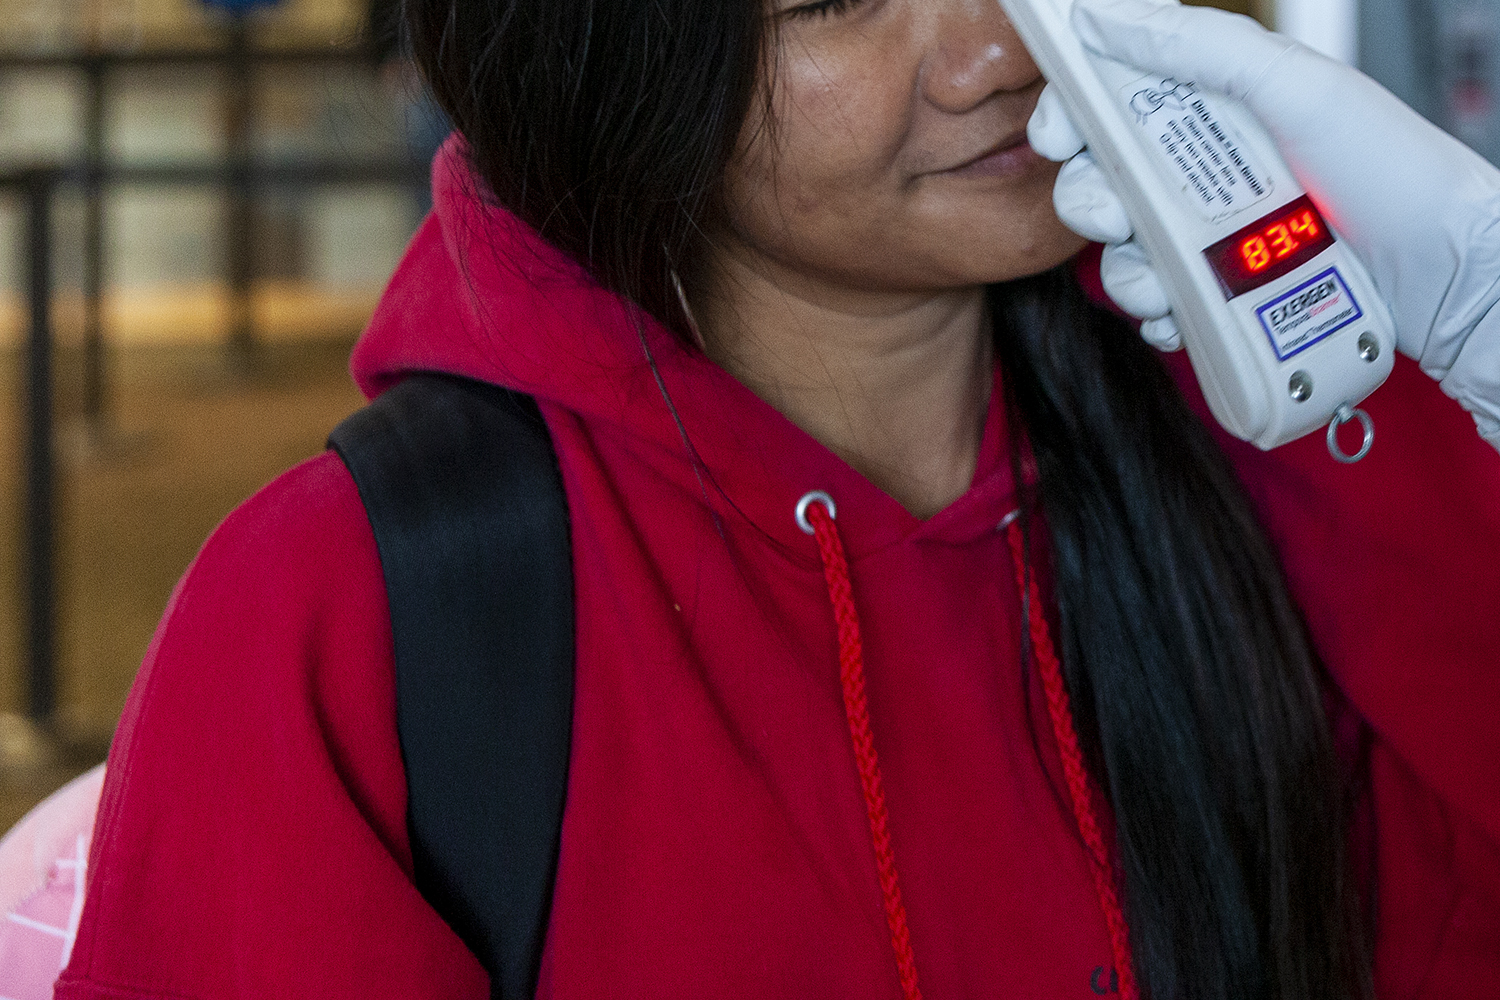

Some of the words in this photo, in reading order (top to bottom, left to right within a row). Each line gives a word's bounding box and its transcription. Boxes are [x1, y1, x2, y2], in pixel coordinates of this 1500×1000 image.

[1181, 113, 1205, 142] Clean
[1218, 164, 1239, 187] lens
[1207, 120, 1227, 143] lens
[1173, 152, 1193, 173] and
[1183, 141, 1201, 160] two
[1194, 156, 1221, 188] weeks
[1214, 183, 1236, 206] with
[1270, 276, 1337, 326] EXERGEN
